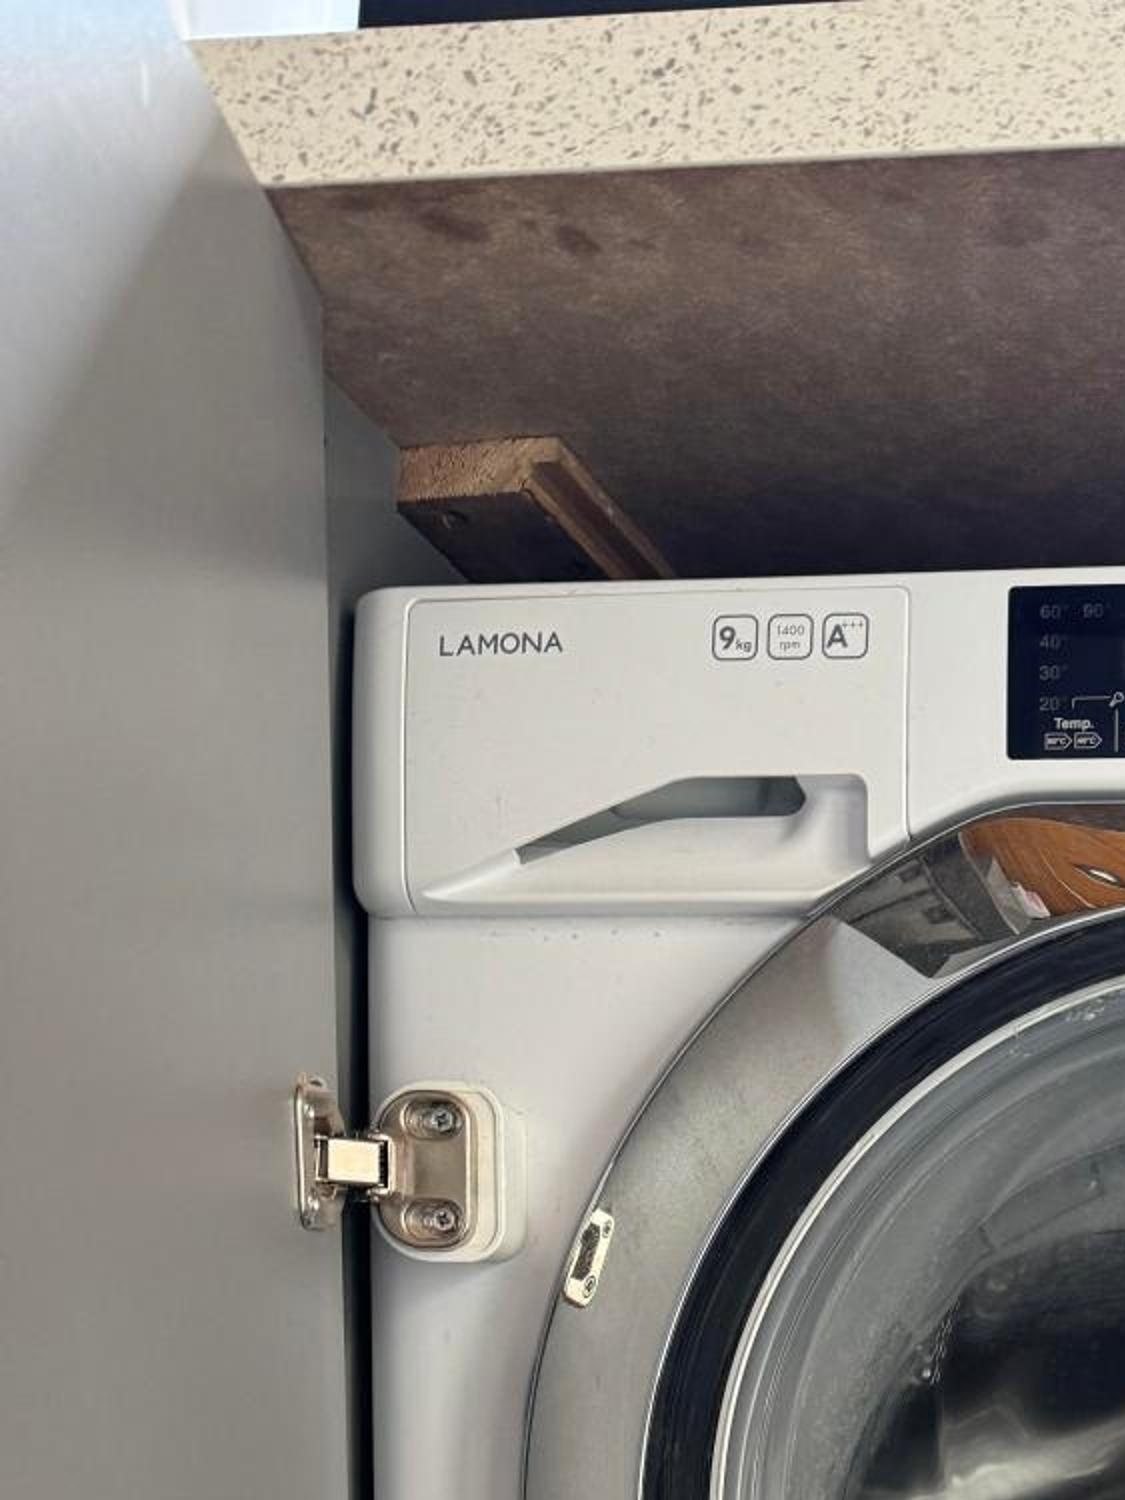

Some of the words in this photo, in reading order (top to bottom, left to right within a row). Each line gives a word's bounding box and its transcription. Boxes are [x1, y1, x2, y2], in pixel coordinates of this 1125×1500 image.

[777, 624, 805, 636] 1400
[439, 631, 564, 658] LAMONA
[779, 639, 801, 651] rpm
[1053, 717, 1095, 732] Temp.
